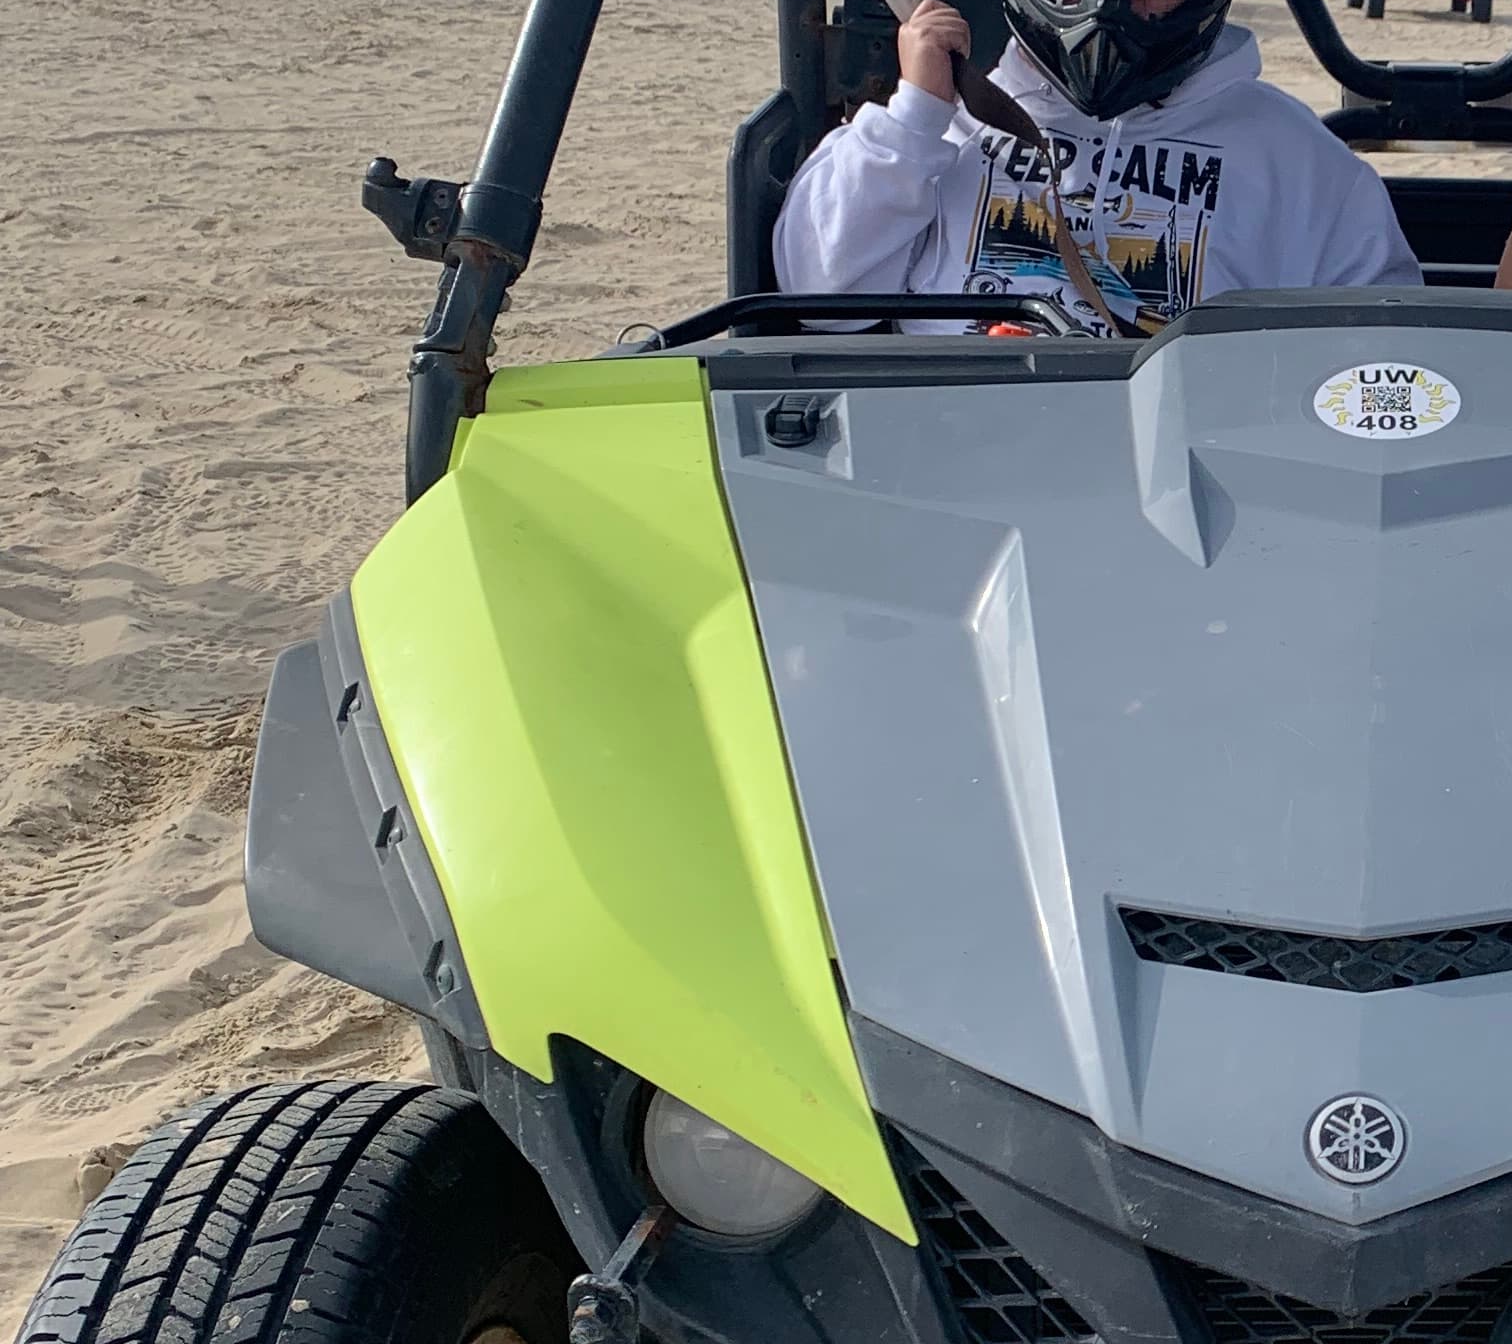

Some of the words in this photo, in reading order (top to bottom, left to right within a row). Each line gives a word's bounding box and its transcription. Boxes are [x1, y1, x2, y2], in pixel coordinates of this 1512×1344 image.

[1092, 144, 1223, 212] CALM
[1065, 216, 1094, 233] AN
[1358, 369, 1419, 385] UW
[1355, 414, 1418, 431] 408
